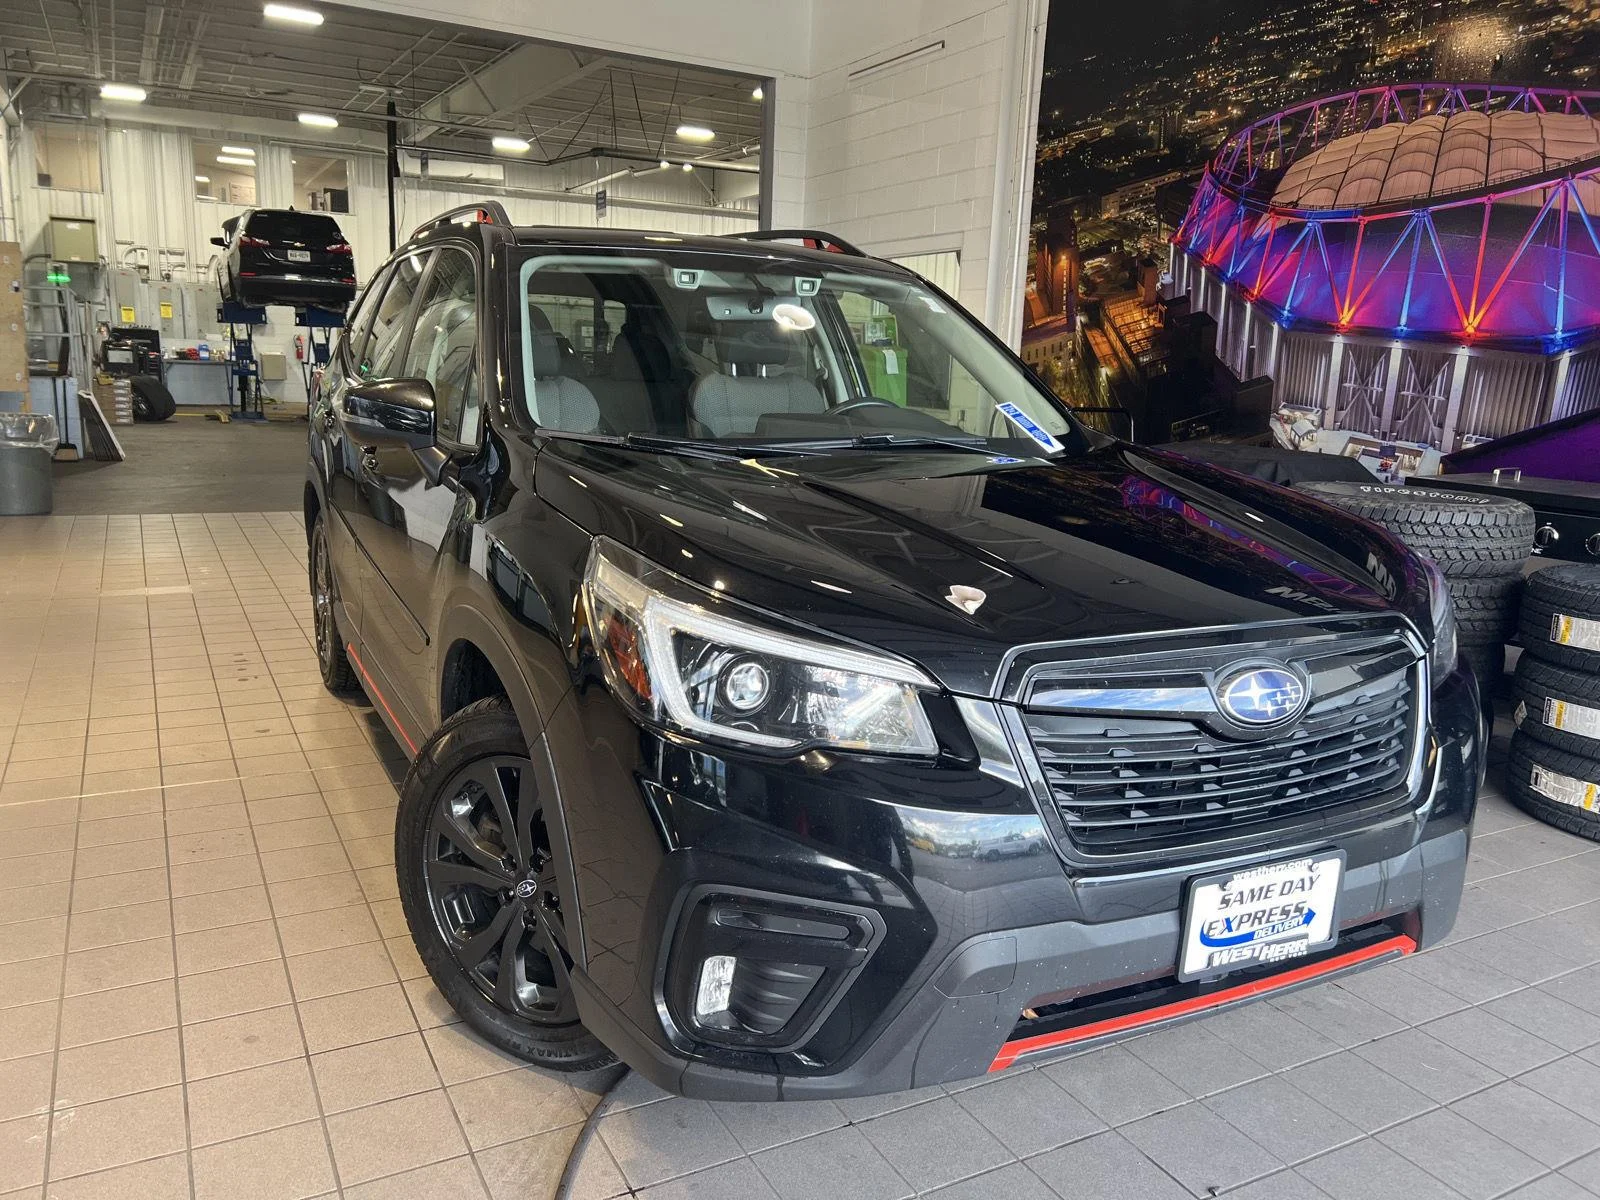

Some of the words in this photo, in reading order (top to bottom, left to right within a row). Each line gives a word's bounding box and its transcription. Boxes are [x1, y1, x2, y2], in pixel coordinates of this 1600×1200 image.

[1218, 884, 1275, 910] SAME
[1280, 874, 1320, 897] DAY
[1206, 901, 1307, 937] EXPRESS
[1253, 916, 1306, 940] DELIVERY
